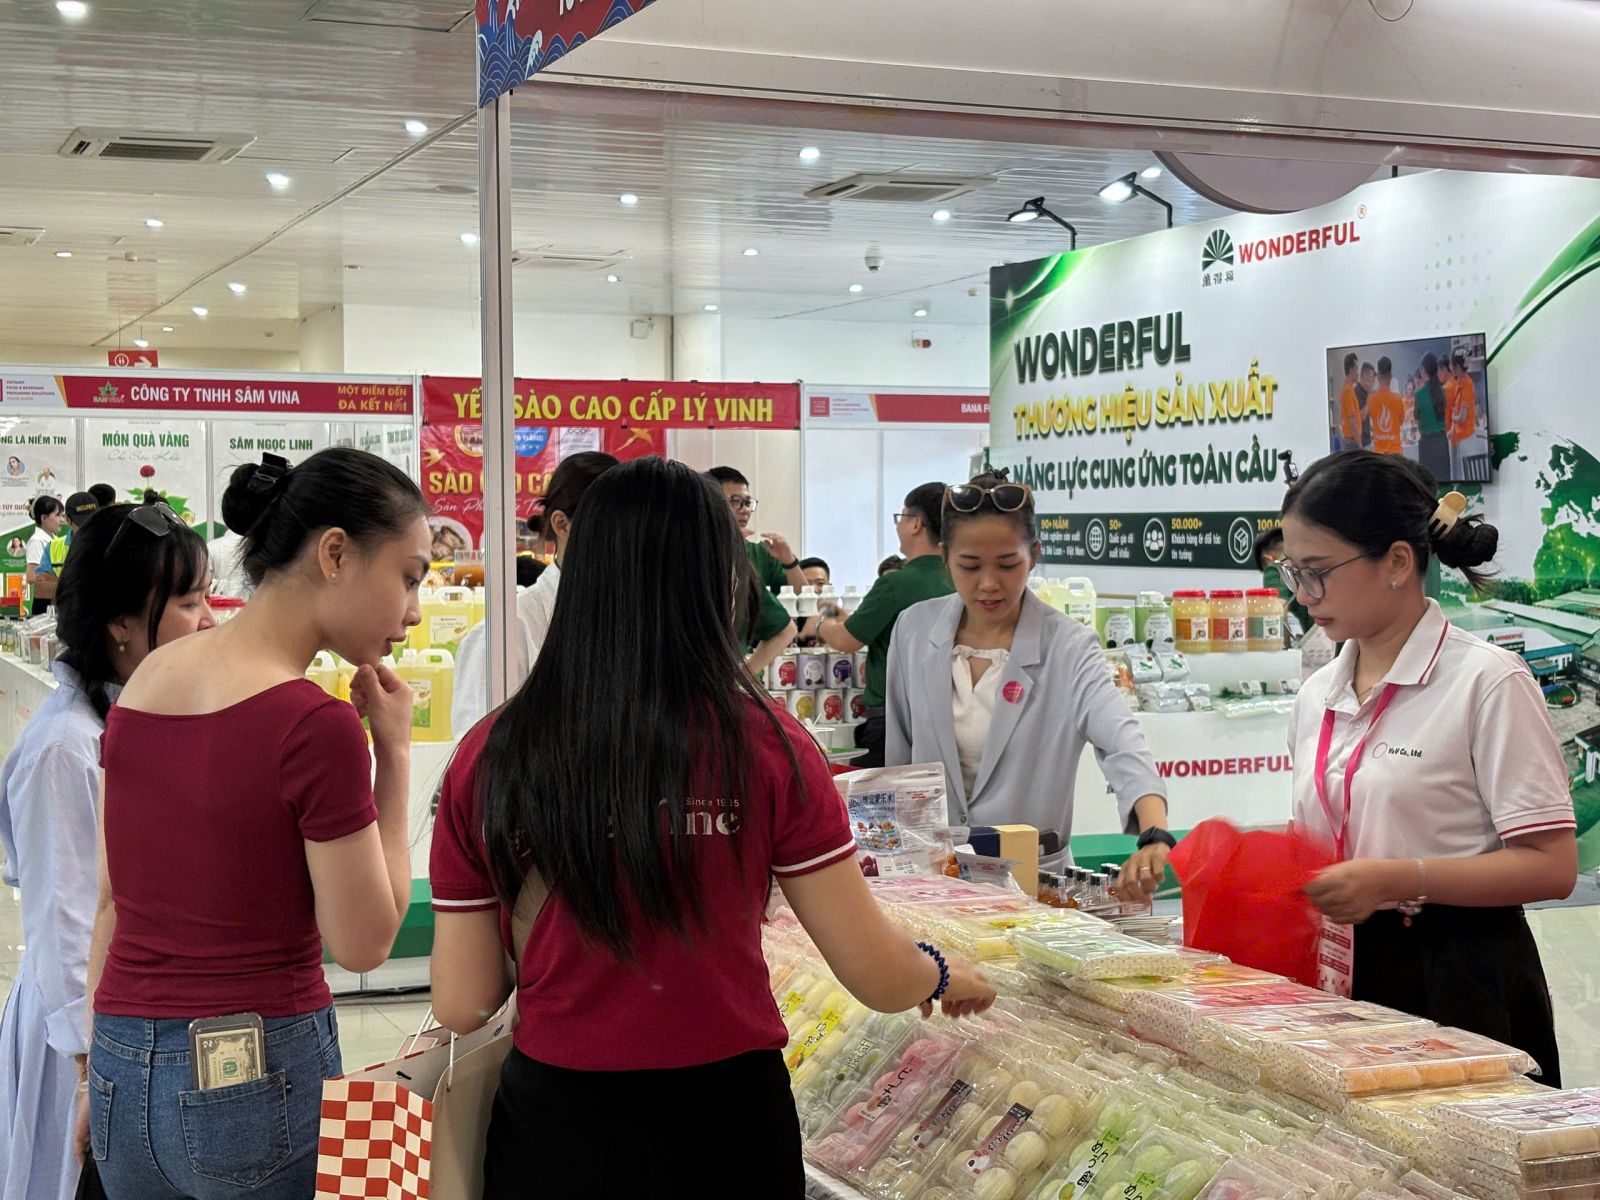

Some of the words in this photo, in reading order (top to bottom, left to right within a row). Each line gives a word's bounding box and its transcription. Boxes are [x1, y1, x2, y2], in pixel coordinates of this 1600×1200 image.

[1239, 221, 1360, 264] WONDERFUL
[1014, 311, 1191, 384] WONDERFUL
[131, 383, 169, 401] CÔNG
[173, 387, 190, 401] TY
[194, 388, 231, 403] TNHH
[235, 386, 265, 404] SÂM
[268, 390, 300, 405] VINA
[337, 385, 359, 397] MỘT
[388, 386, 407, 397] ĐẾN
[338, 400, 357, 411] ĐA
[360, 396, 381, 411] KẾT
[453, 387, 484, 419] YẾ
[514, 389, 561, 420] SÀO
[570, 395, 622, 422] CAO
[630, 388, 677, 422] CẤP
[683, 391, 706, 422] LÝ
[714, 397, 774, 423] VINH
[961, 403, 982, 413] BANA
[1014, 395, 1096, 440] THƯƠNG
[1100, 383, 1156, 445] HIỆU
[1157, 370, 1204, 428] SẢN
[1208, 357, 1279, 425] XUẤT
[0, 435, 13, 444] NG
[15, 433, 26, 444] LÀ
[53, 436, 67, 445] TIN
[102, 430, 129, 447] MÓN
[133, 430, 155, 448] QUÀ
[159, 431, 190, 448] VÀNG
[229, 437, 254, 450] SÂM
[257, 438, 286, 453] NGỌC
[289, 439, 313, 451] LINH
[1013, 456, 1054, 492] NĂNG
[1057, 456, 1087, 500] LỰC
[1089, 457, 1136, 490] CUNG
[1138, 449, 1177, 488] ỨNG
[1179, 443, 1232, 486] TOÀN
[1235, 434, 1277, 483] CẦU
[429, 467, 473, 495] SÀO
[1109, 519, 1122, 530] 50+
[1171, 518, 1203, 530] 50.000+
[1171, 532, 1186, 544] Khách
[1198, 533, 1203, 544] &
[1155, 755, 1293, 778] WONDERFUL
[686, 797, 713, 806] Since
